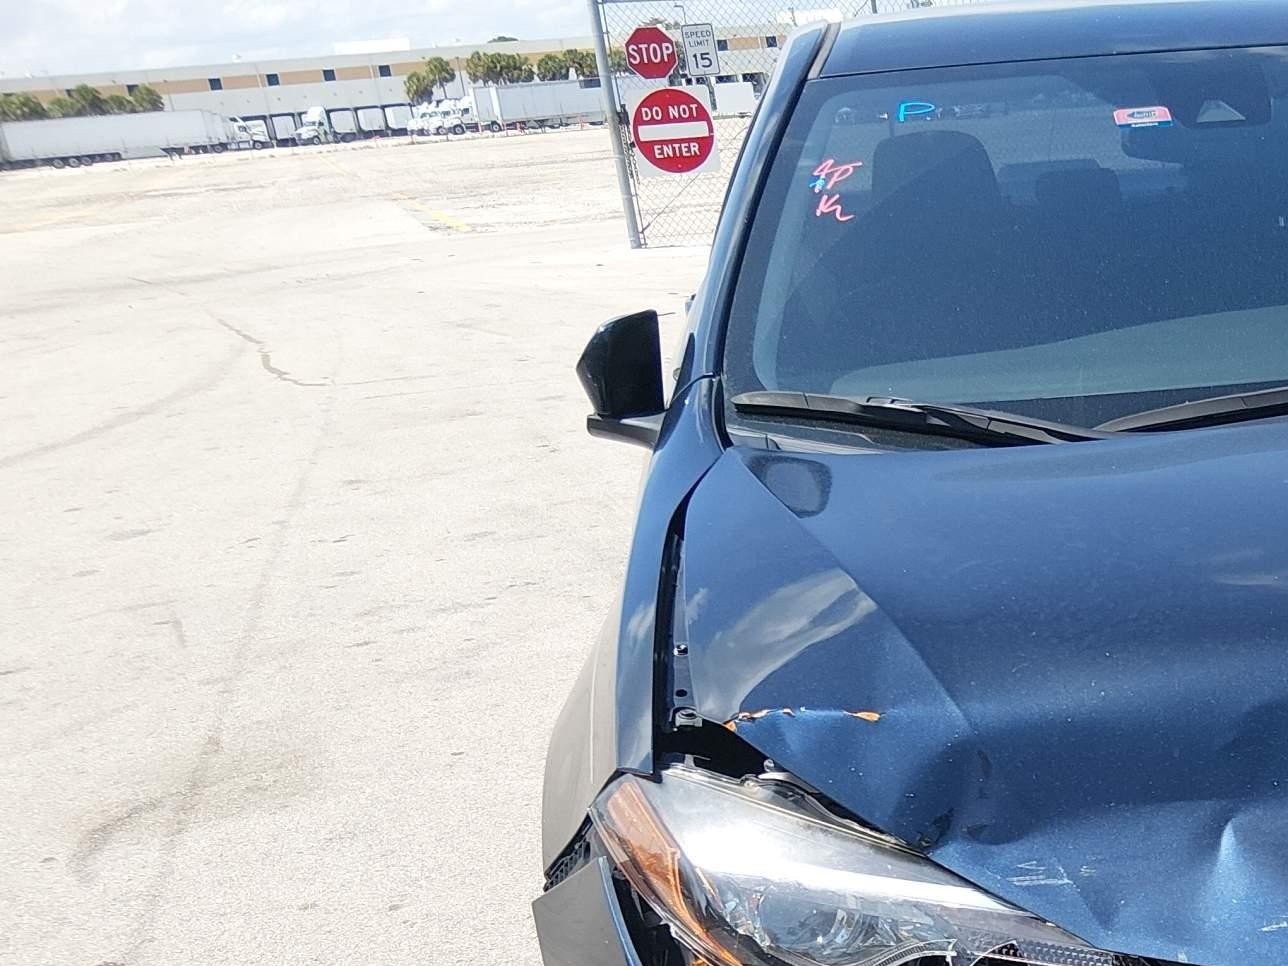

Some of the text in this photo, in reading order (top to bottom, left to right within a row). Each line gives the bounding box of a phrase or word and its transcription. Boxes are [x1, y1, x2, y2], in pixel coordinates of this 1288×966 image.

[684, 30, 711, 38] SPEED
[688, 39, 710, 48] LIMIT
[628, 42, 673, 64] STOP
[692, 52, 712, 68] 15
[641, 104, 698, 121] DO NOT
[653, 142, 700, 158] ENTER
